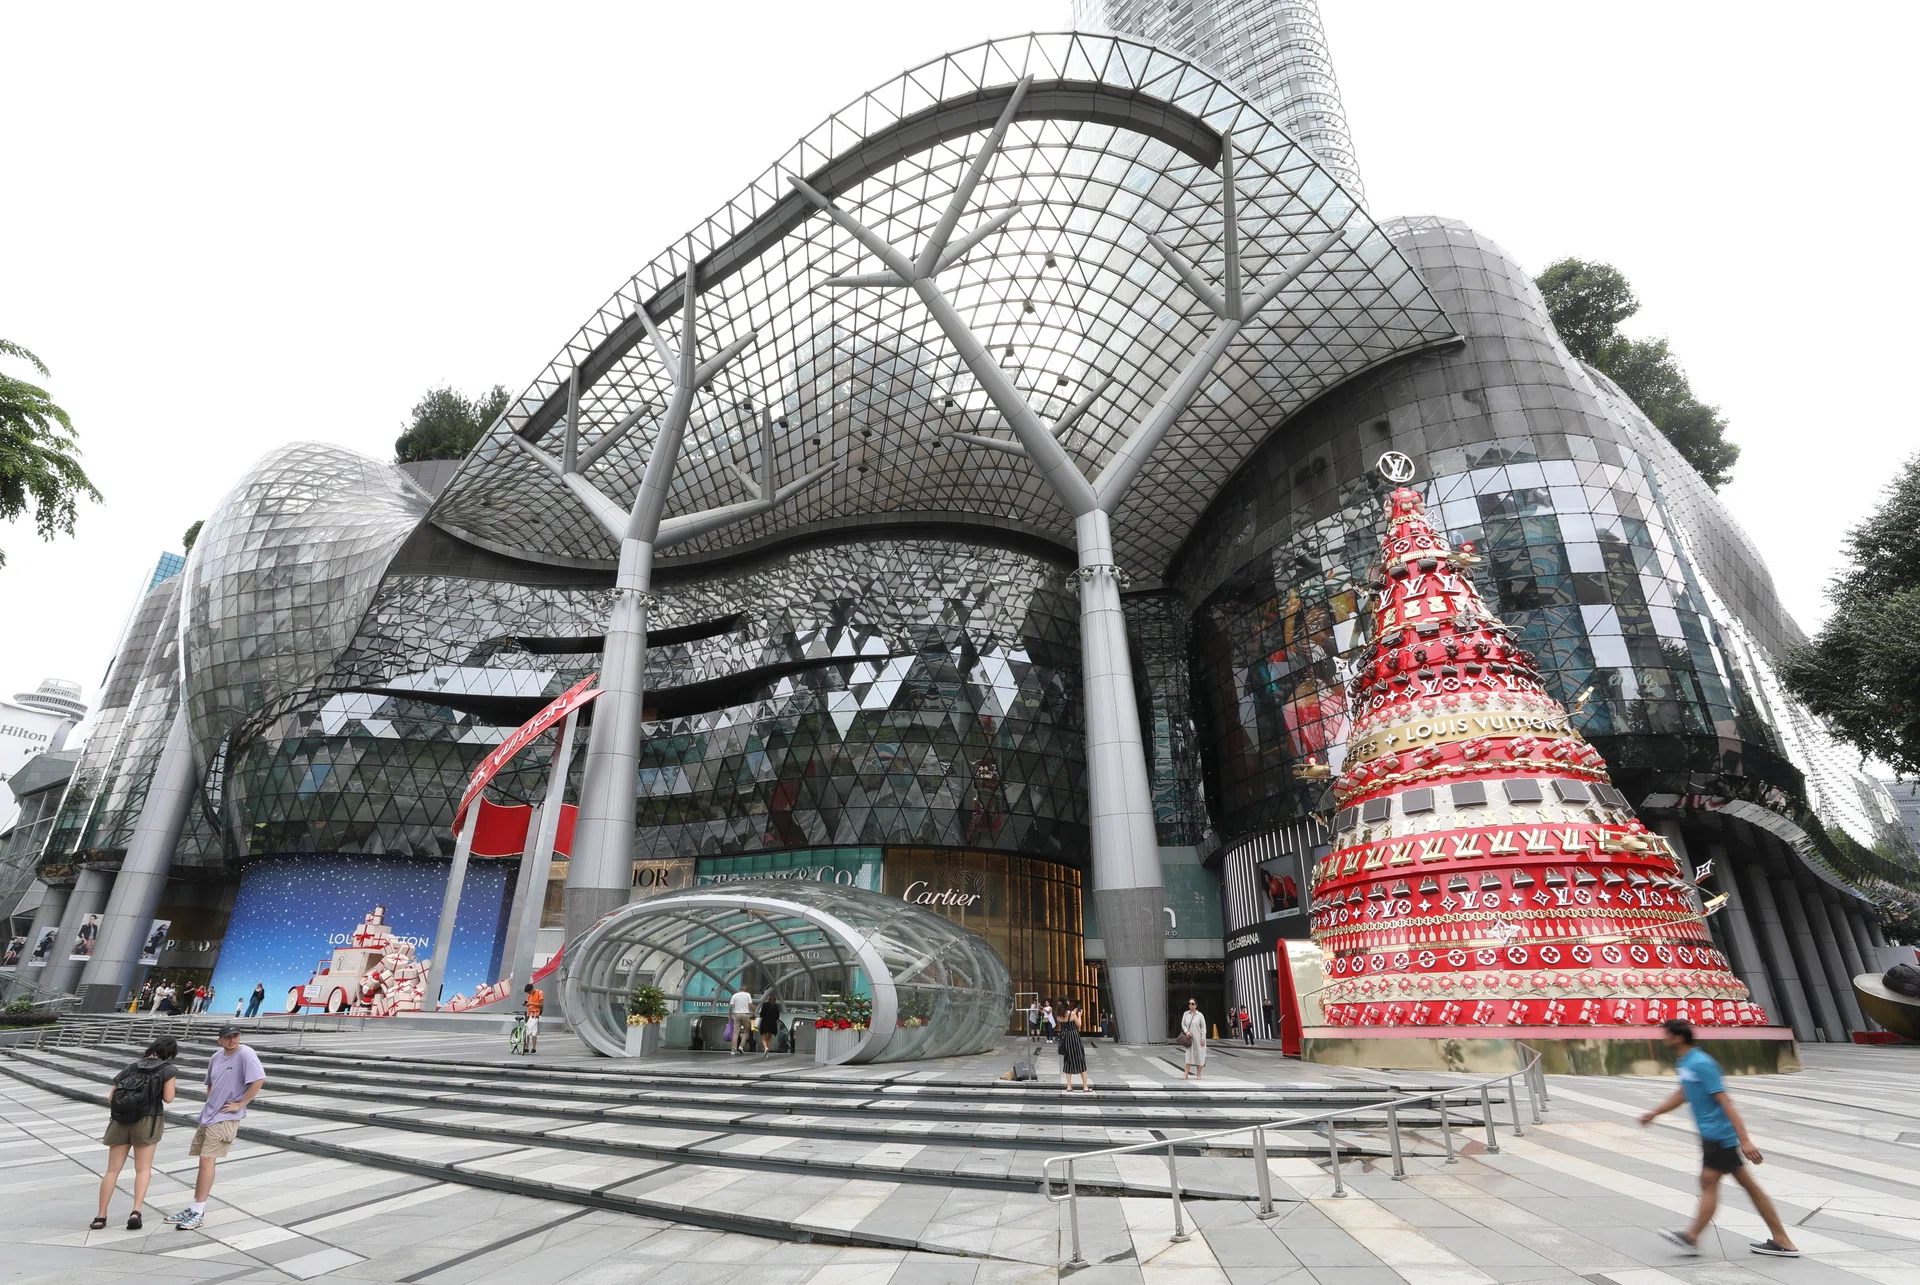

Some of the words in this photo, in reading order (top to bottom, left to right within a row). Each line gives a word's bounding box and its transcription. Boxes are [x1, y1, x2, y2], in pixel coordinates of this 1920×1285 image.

[0, 724, 48, 742] Hilton
[1406, 718, 1469, 742] LOUIS
[1473, 715, 1559, 732] VUITTON
[631, 868, 669, 887] IOR
[903, 880, 980, 906] Cartier
